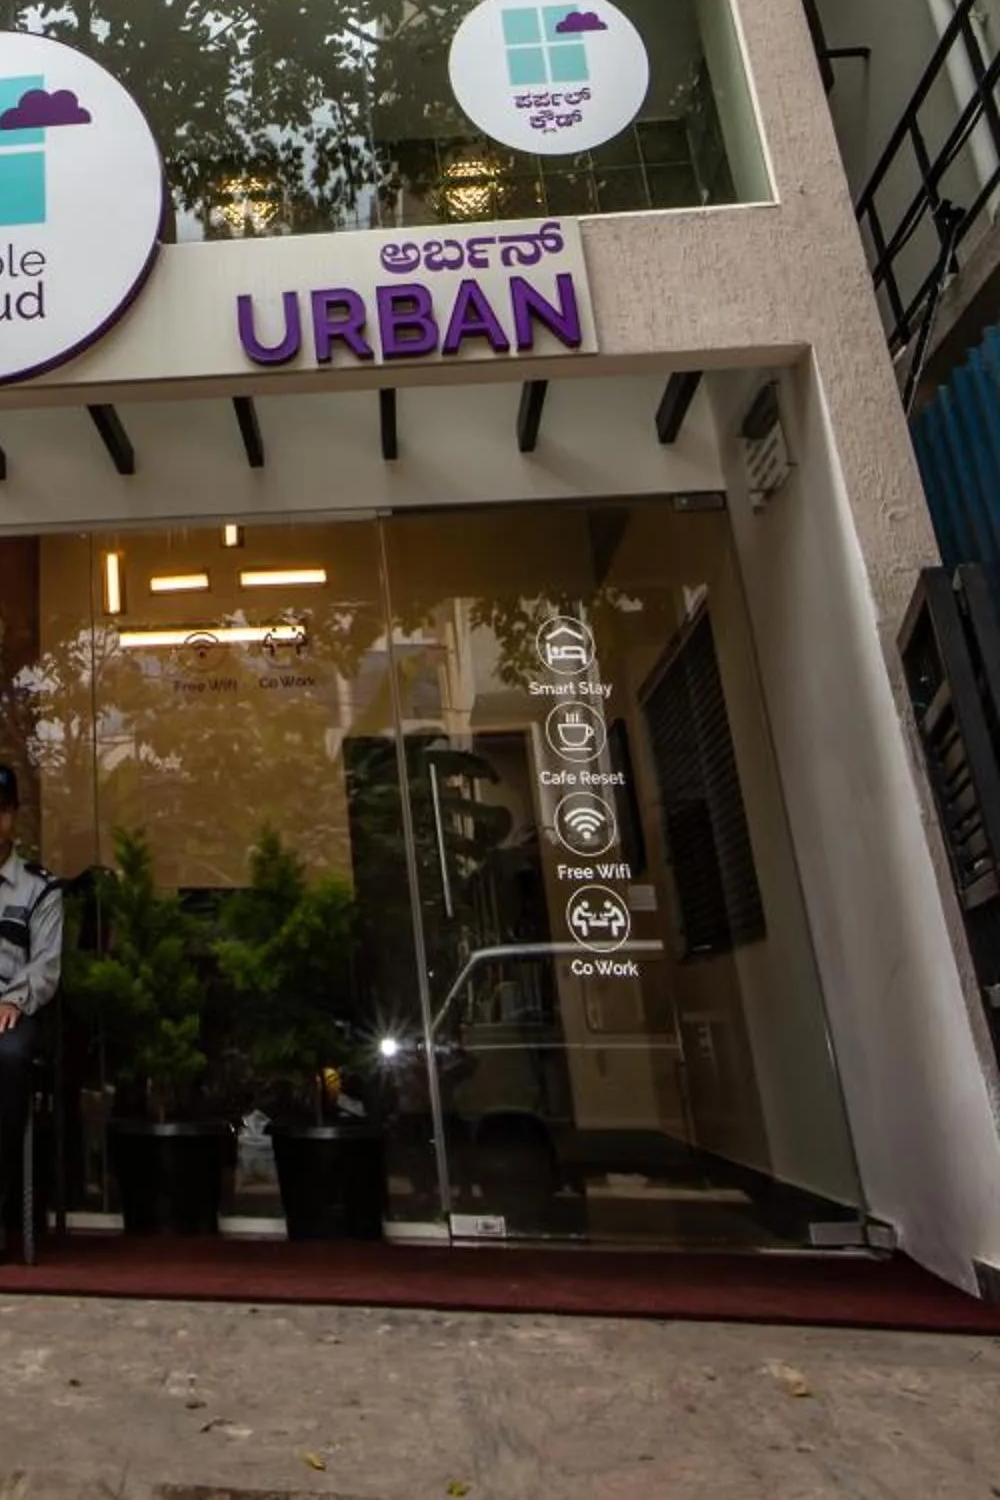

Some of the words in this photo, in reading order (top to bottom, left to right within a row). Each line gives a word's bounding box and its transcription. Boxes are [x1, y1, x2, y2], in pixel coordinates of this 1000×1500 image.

[380, 221, 564, 274] ಅರ್ಬನ್
[237, 273, 582, 367] URBAN
[529, 681, 575, 696] Smart
[578, 681, 612, 700] Stay
[540, 771, 577, 786] Cafe
[580, 771, 626, 786] Reset
[557, 865, 595, 881] Free
[597, 864, 632, 880] Wifi
[571, 960, 594, 976] Co
[597, 960, 639, 976] Work
